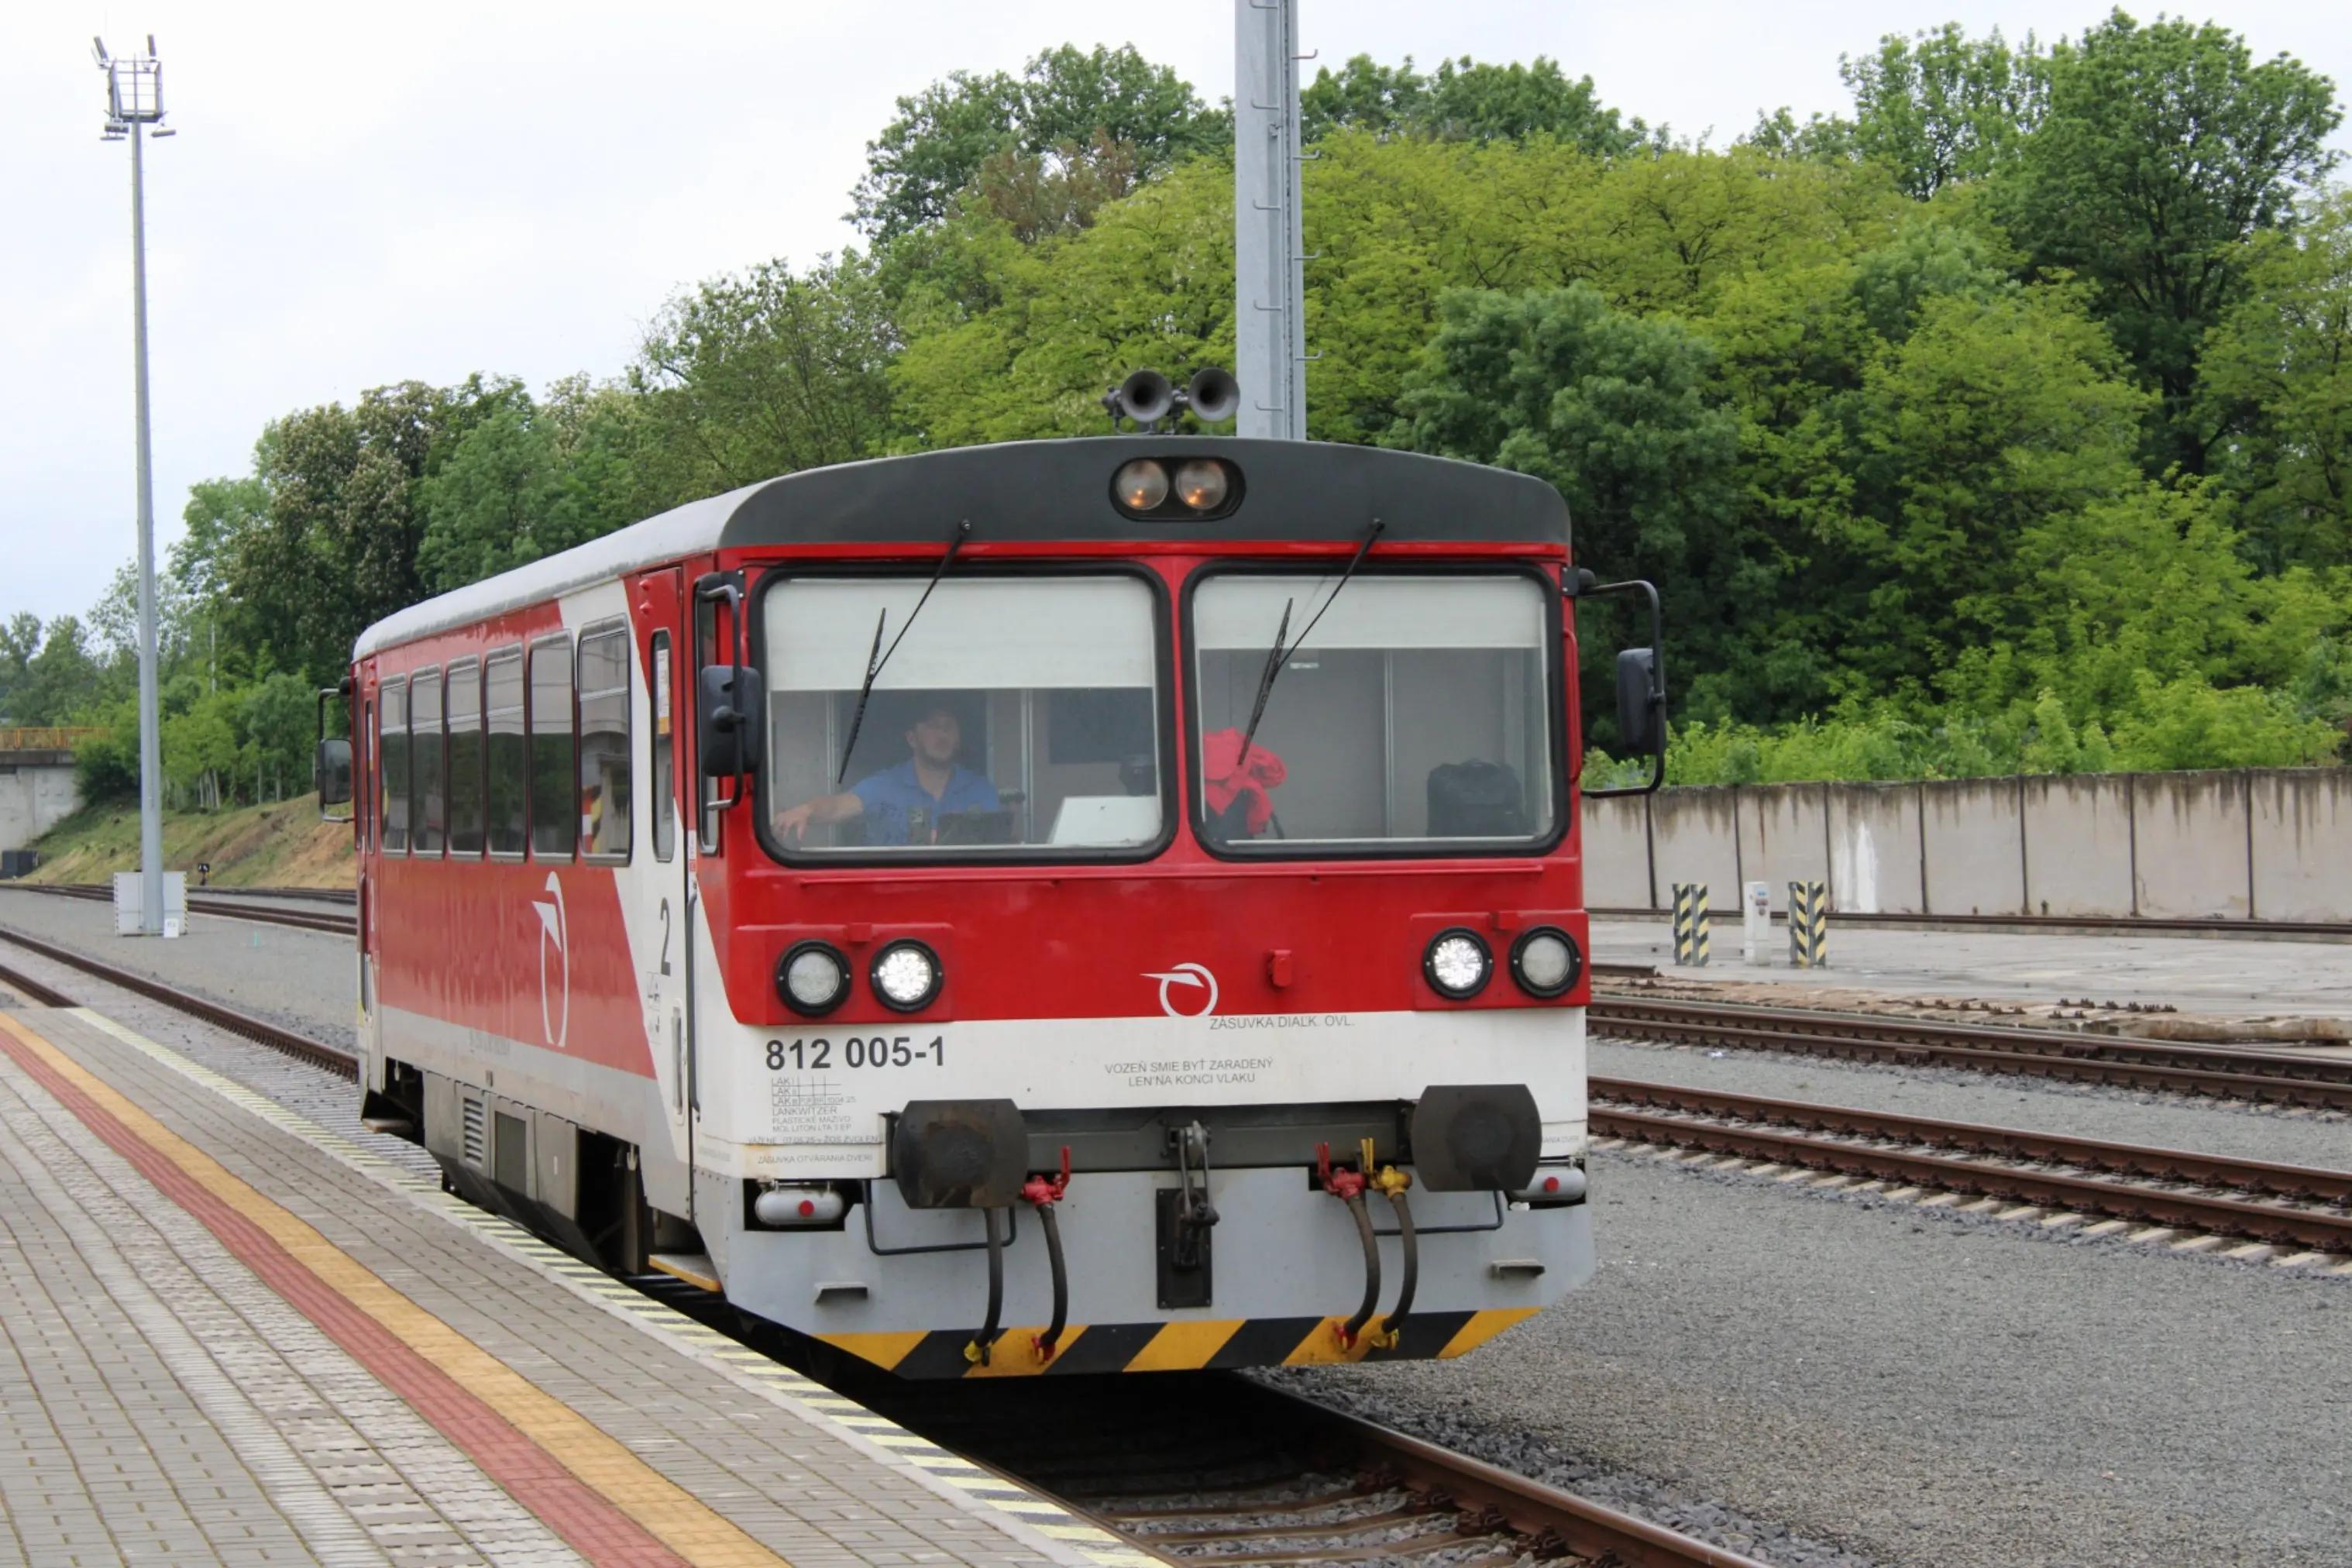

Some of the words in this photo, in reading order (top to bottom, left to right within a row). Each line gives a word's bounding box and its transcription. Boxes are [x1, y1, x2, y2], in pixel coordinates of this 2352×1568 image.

[660, 896, 671, 976] 2
[1210, 1015, 1275, 1030] ZÁSUVKA
[1325, 1014, 1355, 1027] OVL.
[766, 1039, 831, 1070] 812
[845, 1036, 944, 1068] 005-1
[1150, 1061, 1179, 1072] SMIE
[1209, 1057, 1274, 1071] ZARADENÝ
[1175, 1074, 1213, 1085] KONCI
[1216, 1072, 1256, 1084] VLAKU
